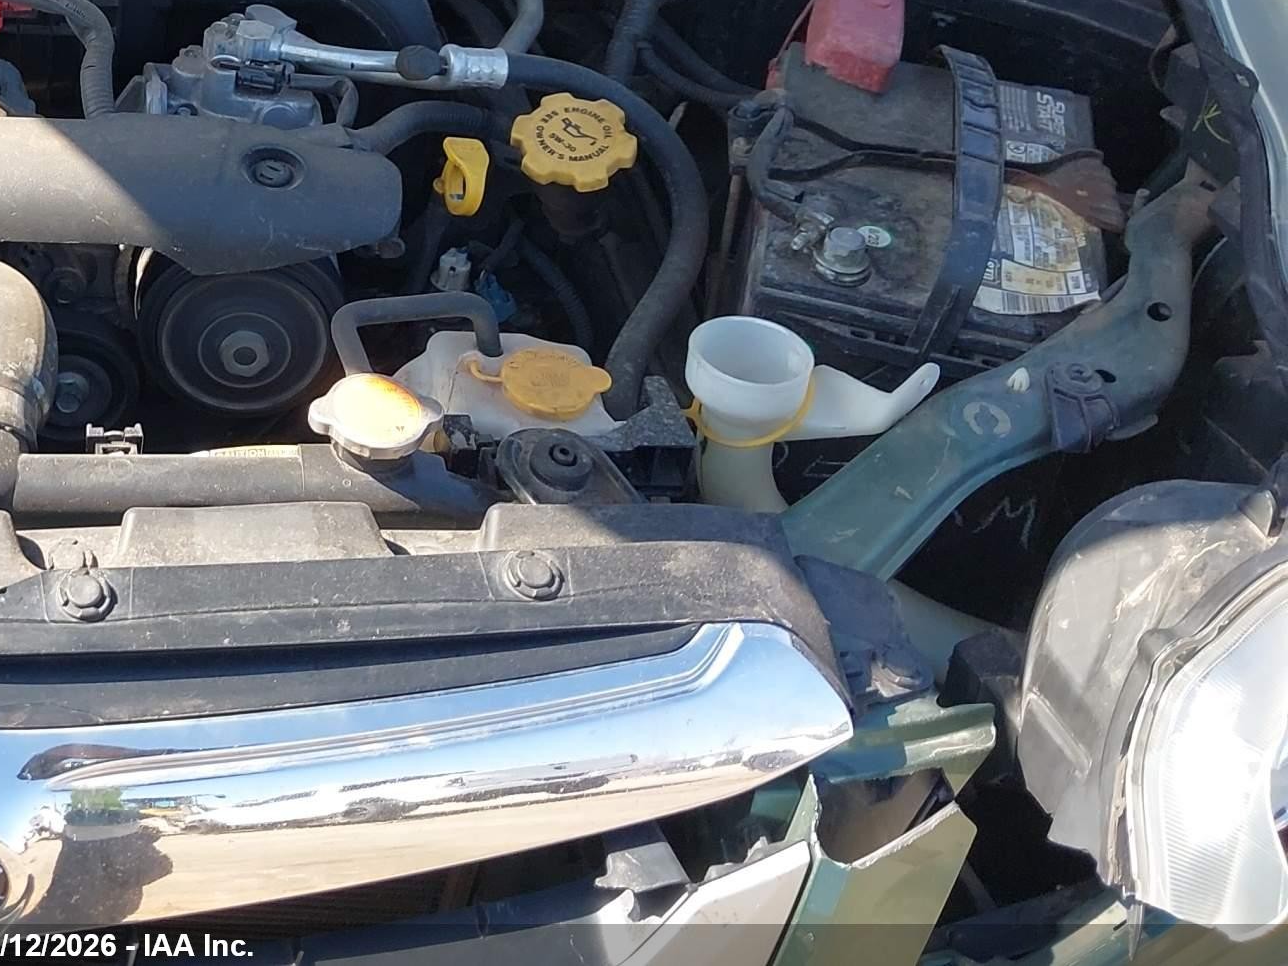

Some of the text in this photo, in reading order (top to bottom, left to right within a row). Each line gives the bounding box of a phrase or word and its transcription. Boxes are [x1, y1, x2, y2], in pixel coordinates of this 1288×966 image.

[535, 110, 610, 162] SEE OWNER'S MANUAL
[563, 107, 614, 139] ENGINE OIL
[548, 132, 577, 153] 5W-30
